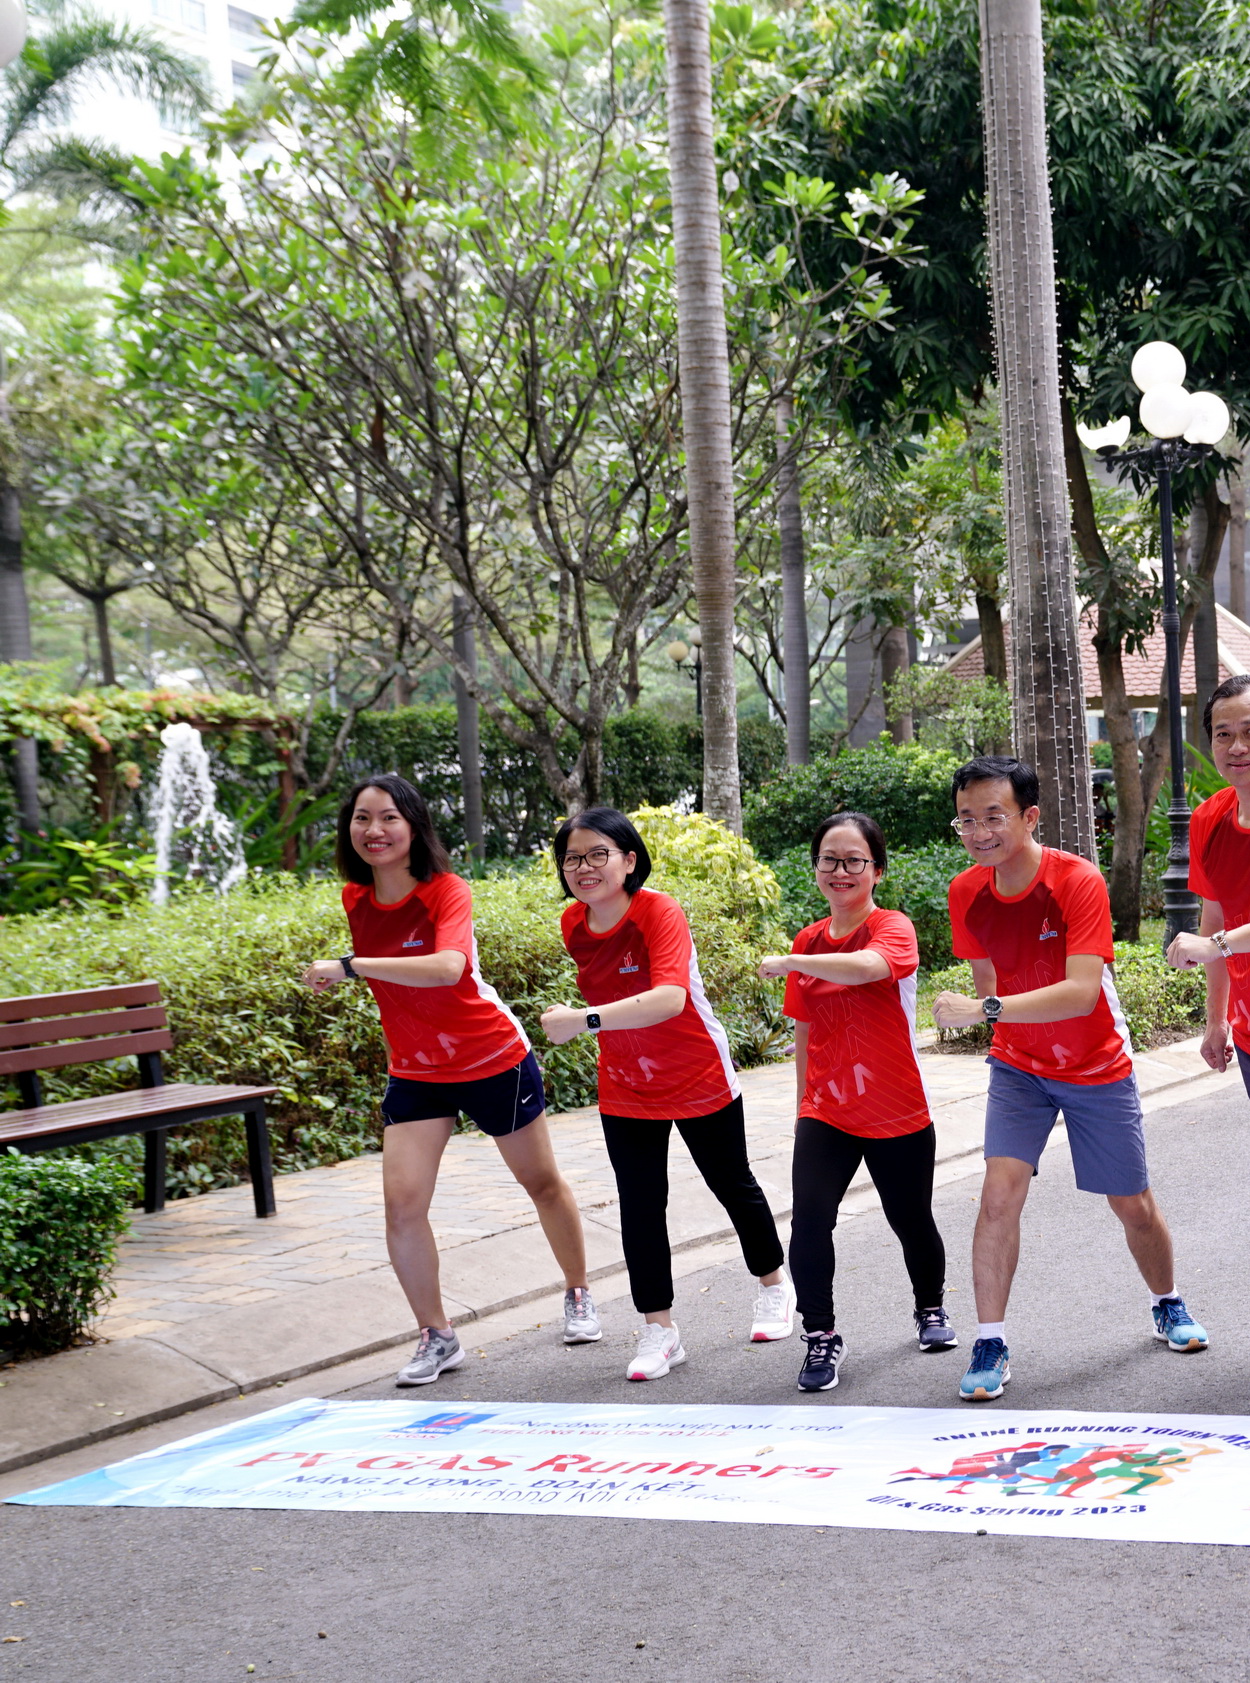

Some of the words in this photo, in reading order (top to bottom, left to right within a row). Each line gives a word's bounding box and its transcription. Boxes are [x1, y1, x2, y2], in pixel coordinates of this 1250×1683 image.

[932, 1427, 1019, 1442] ONLINE
[1027, 1425, 1138, 1434] RUNNING
[355, 1451, 526, 1472] GAS
[523, 1453, 844, 1479] Runners
[918, 1502, 967, 1514] Gas
[969, 1506, 1064, 1517] Spring
[1069, 1504, 1147, 1516] 2023
